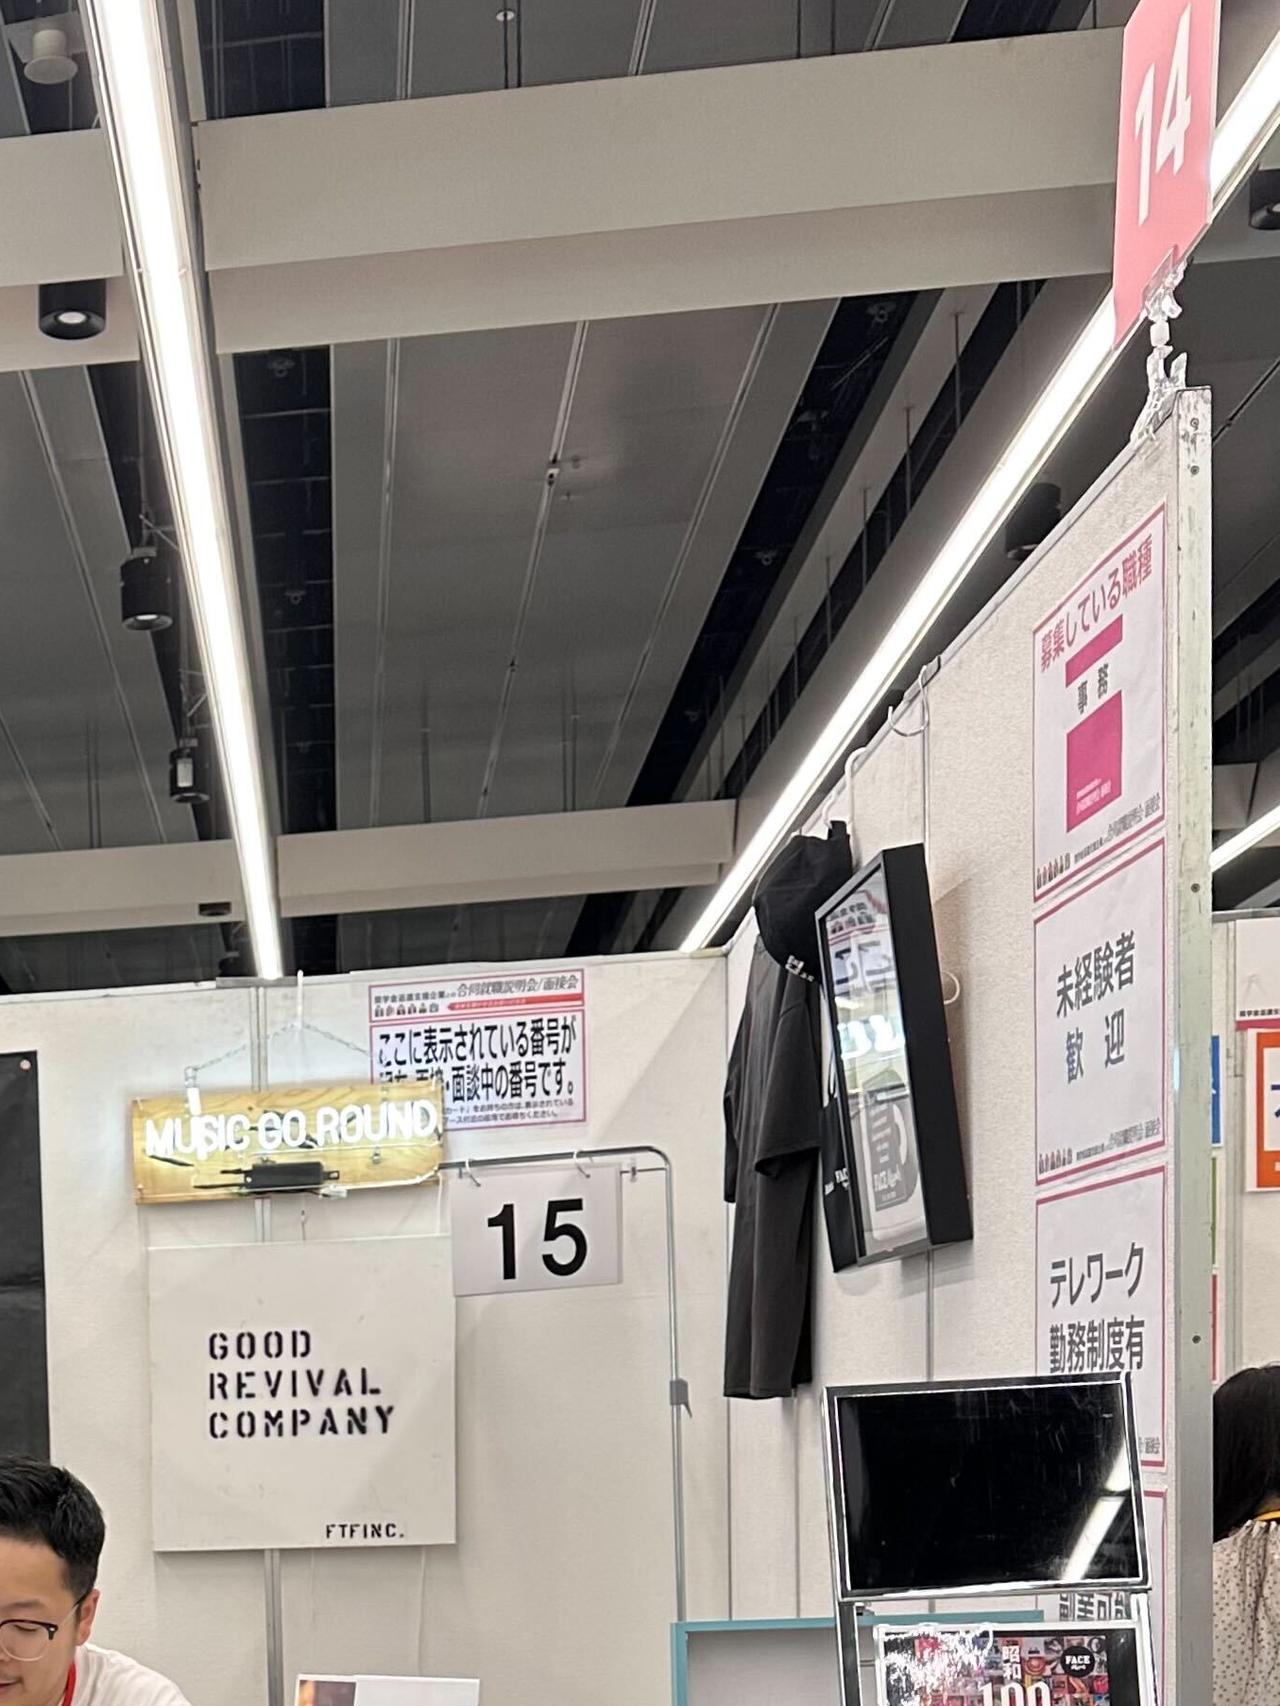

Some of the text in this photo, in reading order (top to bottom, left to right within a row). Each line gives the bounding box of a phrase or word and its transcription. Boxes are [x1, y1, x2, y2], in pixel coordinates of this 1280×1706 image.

[1134, 3, 1193, 227] 14
[1041, 533, 1153, 674] 募集している職種
[1057, 930, 1135, 1019] 未経験者
[379, 1015, 577, 1067] ここに表示されている番号が
[1066, 1008, 1125, 1084] 歓迎
[145, 1098, 439, 1158] MUSIC GO ROUND
[487, 1197, 588, 1280] 15
[1050, 1242, 1144, 1309] テレワーク
[209, 1330, 312, 1360] GOOD
[1050, 1314, 1145, 1374] 勤務制度有
[209, 1367, 382, 1400] REVIVAL
[209, 1405, 396, 1439] COMPANY
[1001, 1645, 1022, 1680] 昭和
[1065, 1655, 1091, 1665] FACE
